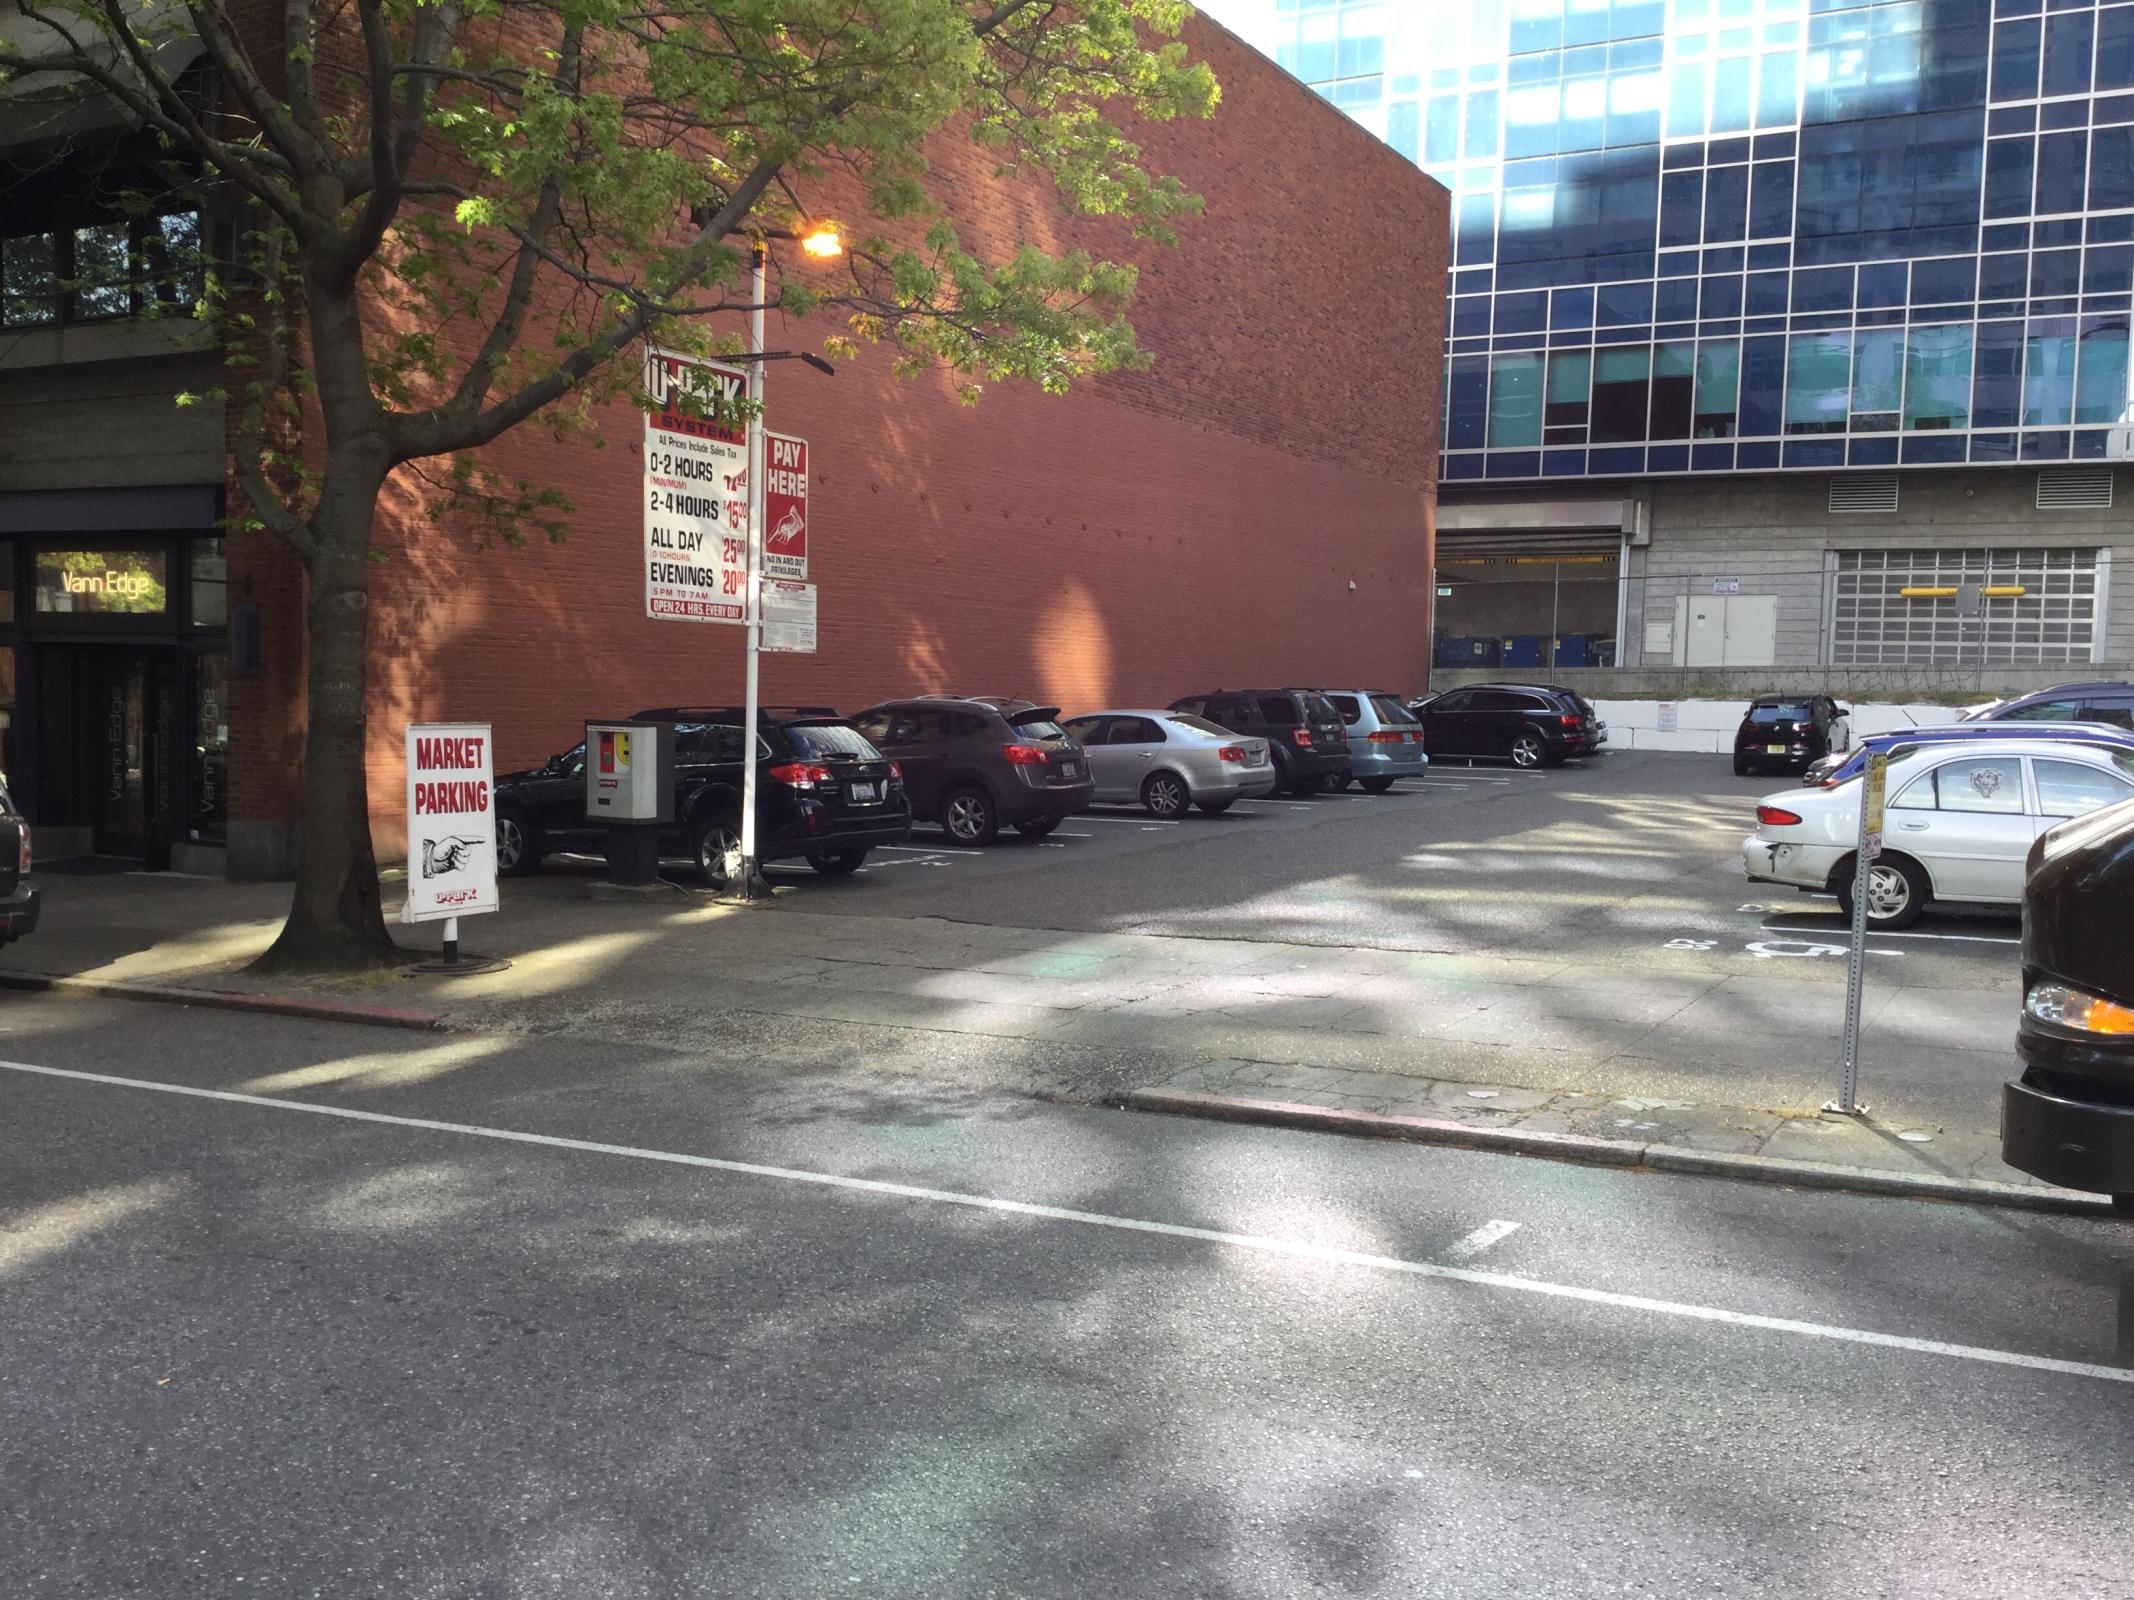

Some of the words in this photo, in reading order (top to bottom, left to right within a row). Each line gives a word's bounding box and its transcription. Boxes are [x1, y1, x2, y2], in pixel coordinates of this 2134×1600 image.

[662, 415, 733, 440] SYSTEM
[659, 434, 667, 446] All
[668, 436, 687, 450] Prices
[689, 440, 708, 454] Include
[710, 445, 726, 457] Sales
[727, 448, 737, 459] Tax
[773, 440, 802, 468] PAY
[650, 452, 672, 475] 0-2
[675, 456, 713, 482] HOURS
[768, 468, 806, 498] HERE
[651, 491, 674, 514] 2-4
[676, 494, 719, 520] HOURS
[651, 527, 674, 549] ALL
[678, 530, 703, 552] DAY
[651, 561, 714, 588] EVENINGS
[766, 554, 775, 563] NO
[783, 557, 794, 566] AND
[794, 558, 805, 567] OUT
[62, 571, 103, 593] Vann
[105, 571, 149, 600] Edge
[677, 589, 686, 598] TO
[653, 599, 674, 613] OPEN
[674, 601, 686, 614] 24
[705, 604, 726, 617] EVERY
[727, 606, 740, 618] DAY
[108, 686, 125, 743] Edge
[416, 738, 484, 770] MARKET
[108, 747, 123, 801] Vann
[200, 755, 214, 813] Vann
[415, 781, 488, 815] PARKING
